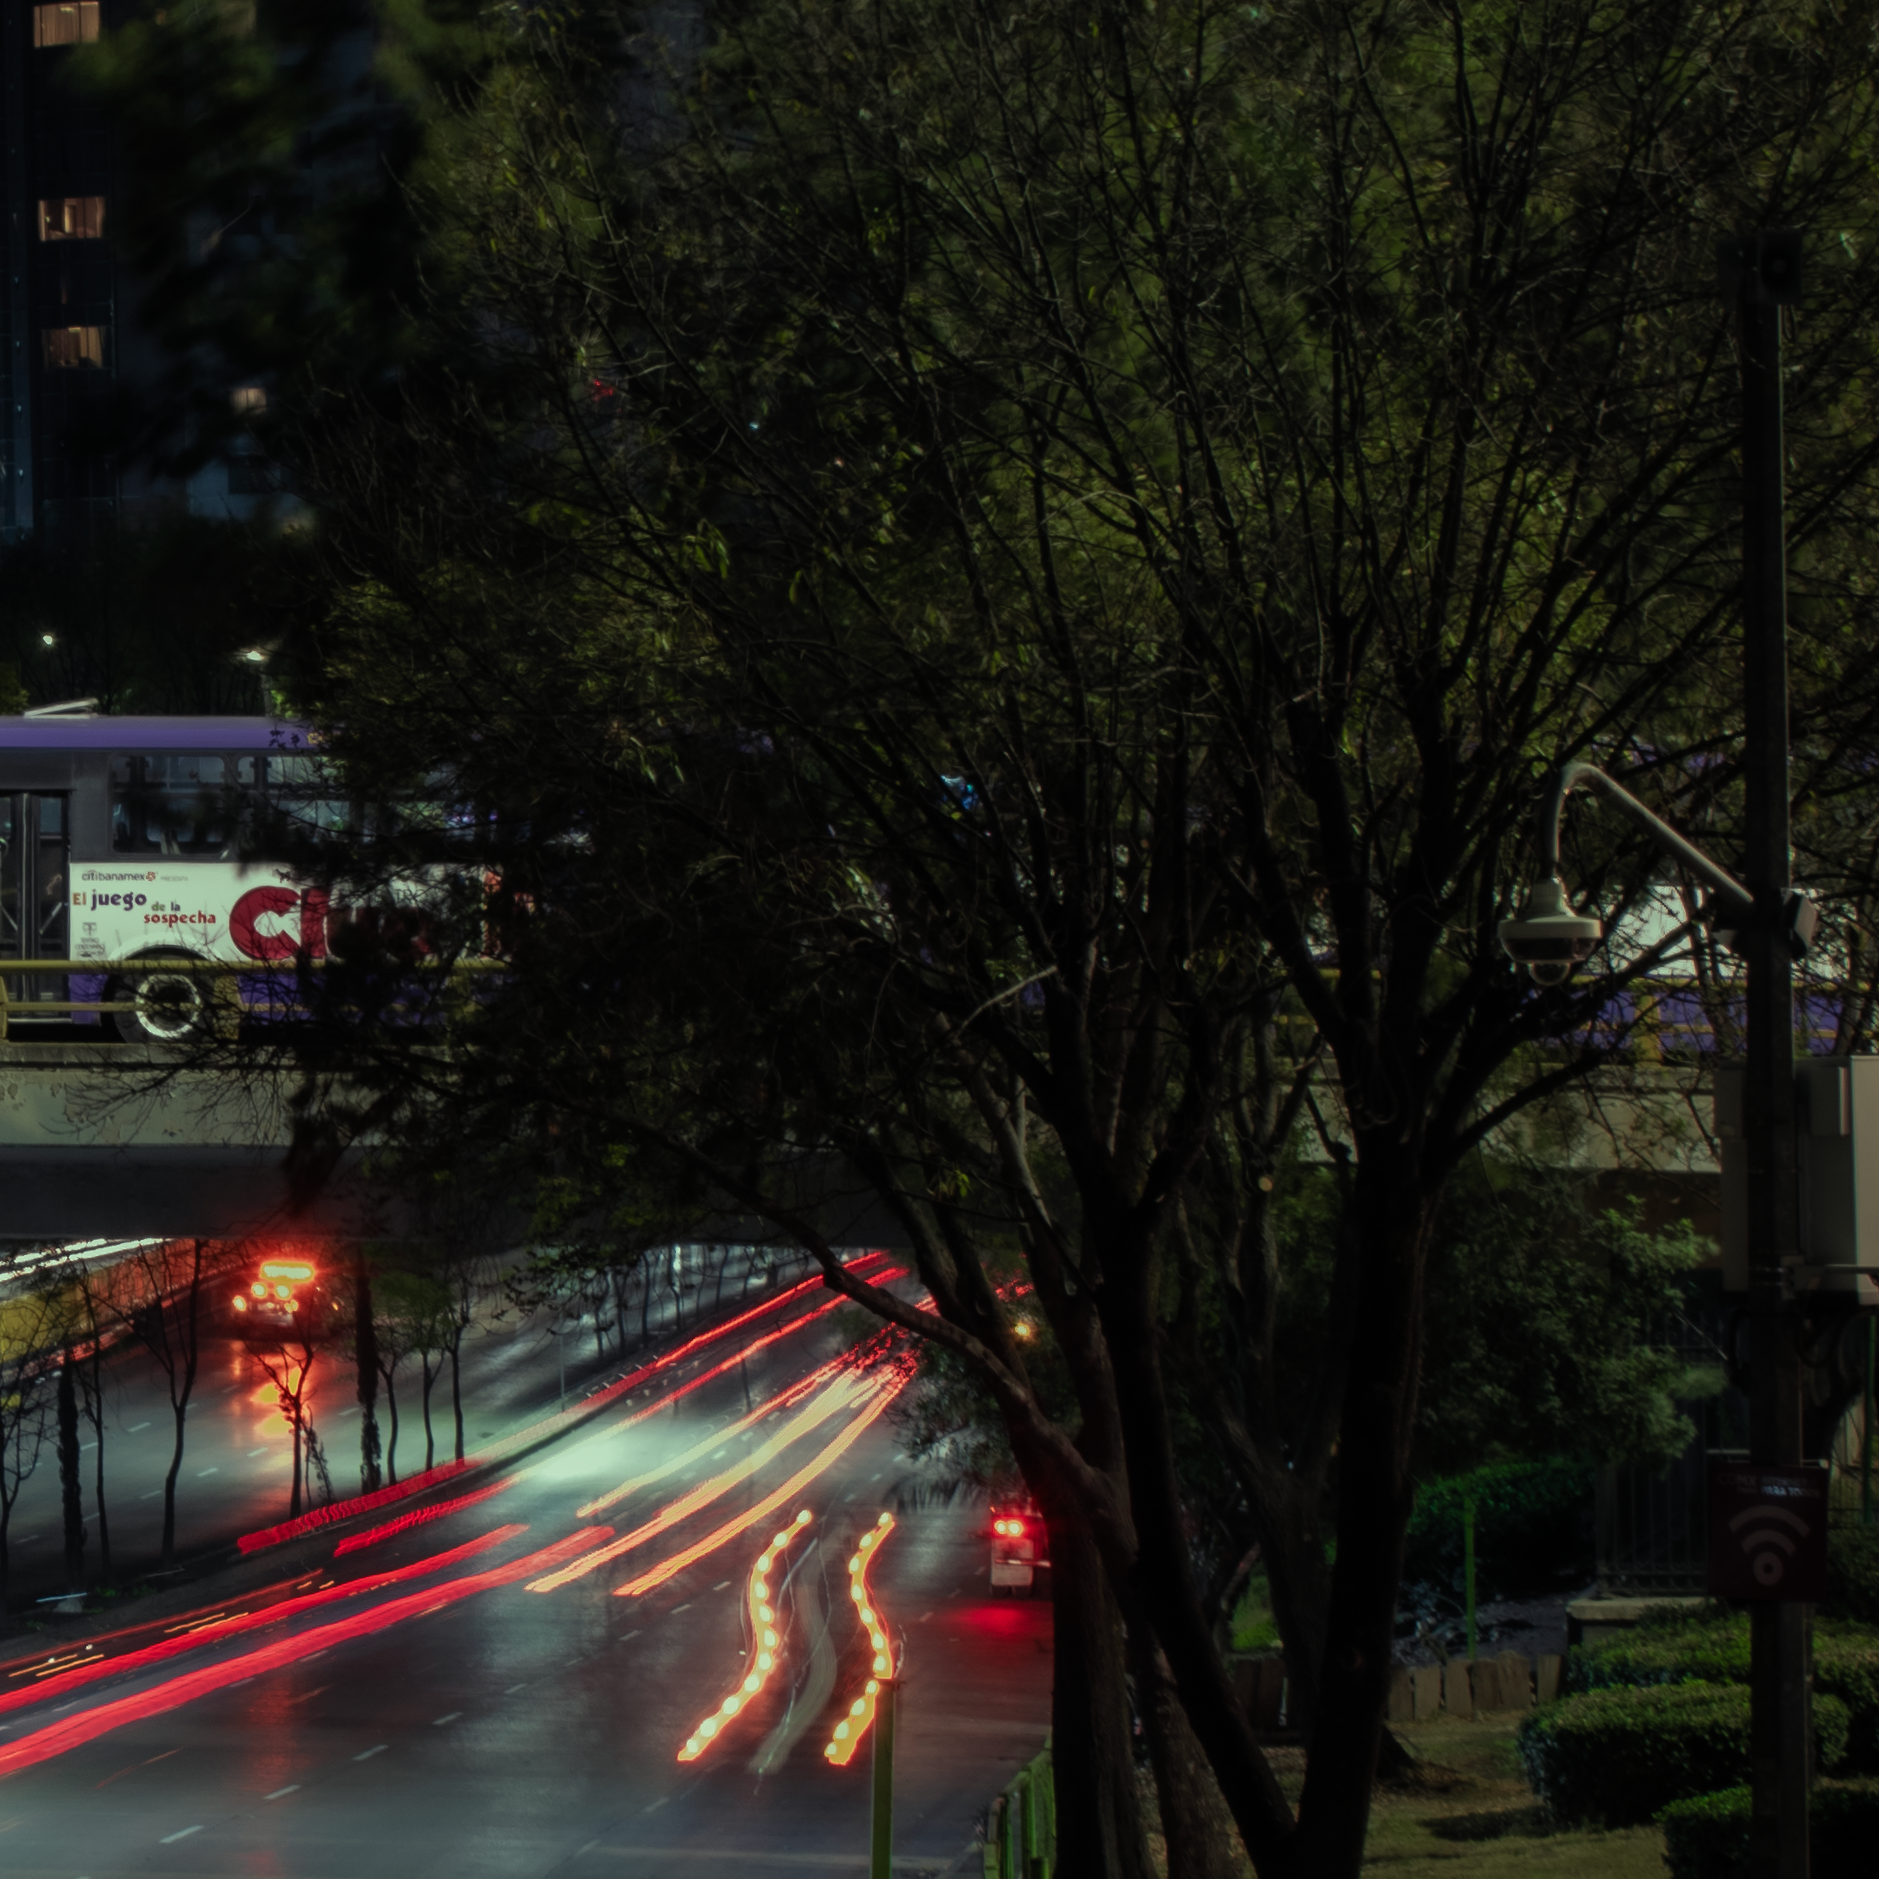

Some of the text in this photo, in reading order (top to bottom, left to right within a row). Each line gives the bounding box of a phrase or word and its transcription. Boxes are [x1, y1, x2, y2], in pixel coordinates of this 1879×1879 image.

[81, 870, 145, 882] citibanamex
[72, 888, 147, 912] El juego
[151, 900, 181, 913] de la
[143, 910, 217, 929] sospecha
